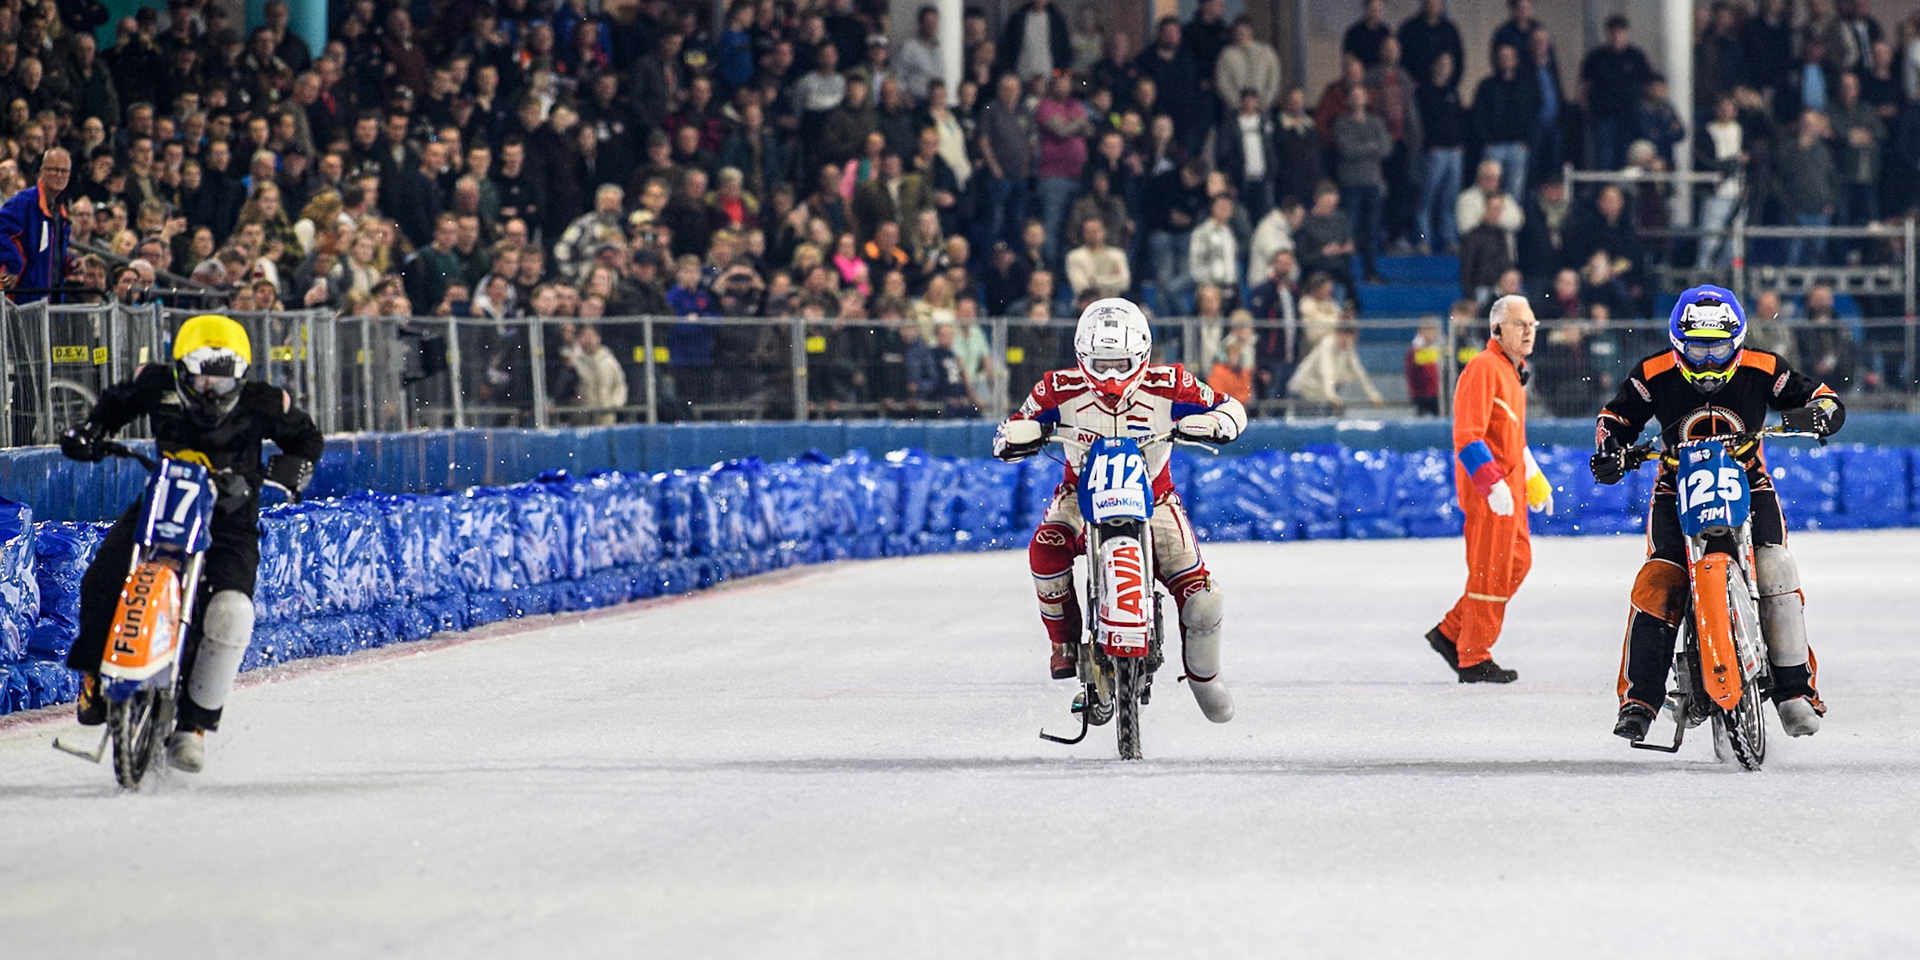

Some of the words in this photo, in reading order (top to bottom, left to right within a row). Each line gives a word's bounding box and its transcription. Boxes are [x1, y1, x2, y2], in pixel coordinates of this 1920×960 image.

[55, 347, 86, 358] D.E.V.
[1087, 453, 1144, 492] 412
[1678, 467, 1743, 515] 125
[153, 478, 201, 524] 17
[1095, 497, 1144, 511] WashKing
[1697, 506, 1726, 524] FIM
[1107, 547, 1144, 620] AVIA
